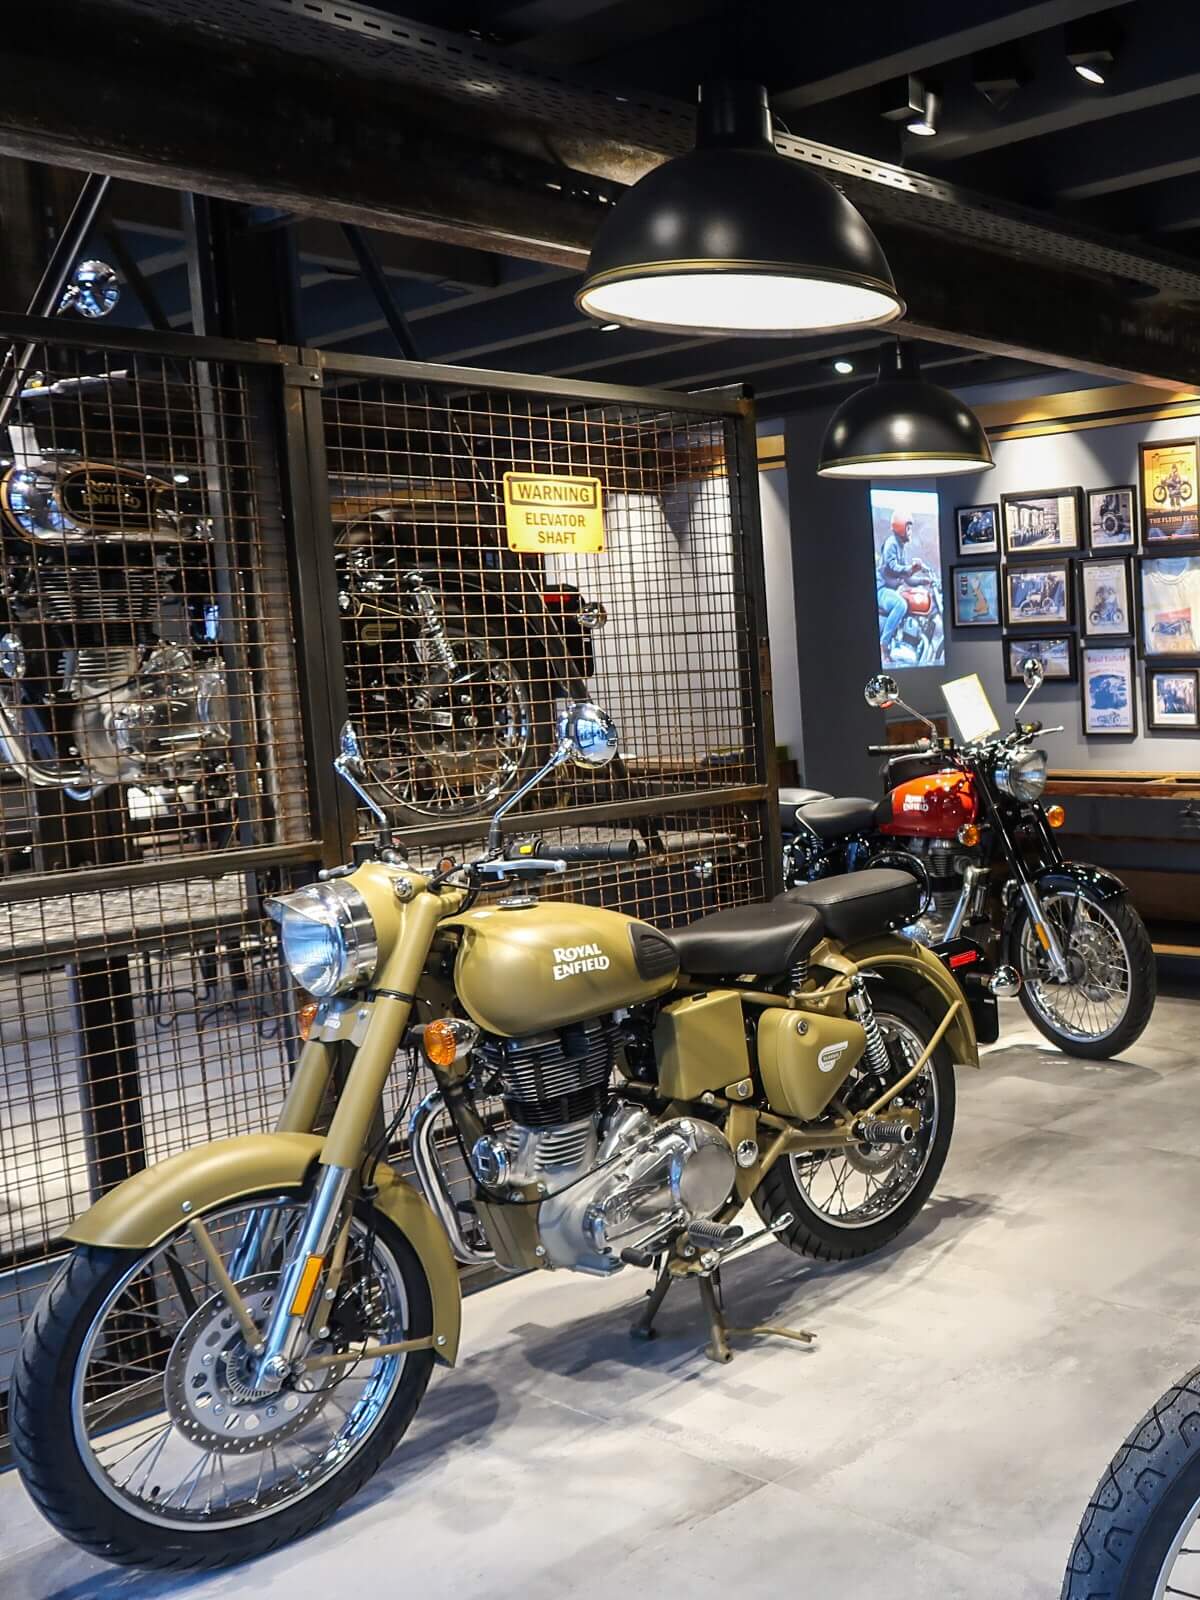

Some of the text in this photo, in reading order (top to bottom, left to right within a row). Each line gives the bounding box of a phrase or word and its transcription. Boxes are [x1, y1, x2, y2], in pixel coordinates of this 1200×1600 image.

[518, 483, 590, 502] WARNING
[525, 512, 586, 527] ELEVATOR
[538, 531, 577, 545] SHAFT
[553, 943, 602, 963] ROYAL
[553, 955, 610, 980] ENFIELD
